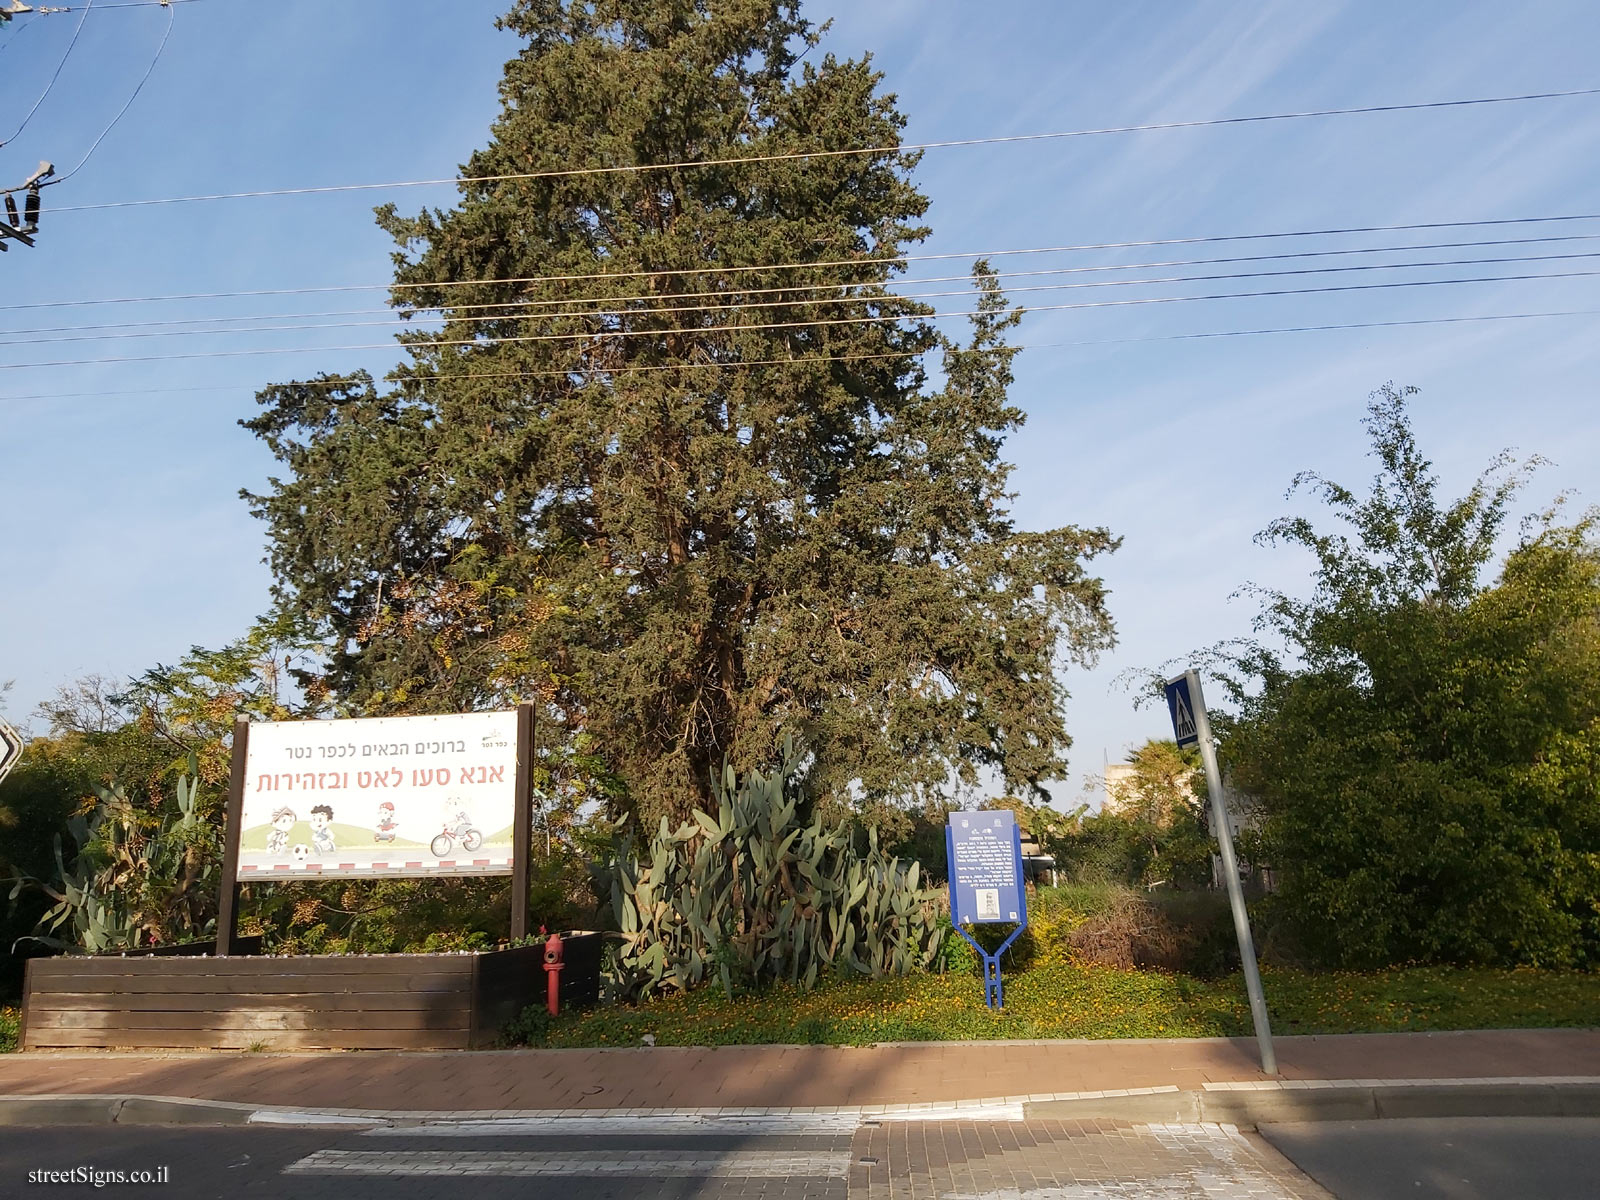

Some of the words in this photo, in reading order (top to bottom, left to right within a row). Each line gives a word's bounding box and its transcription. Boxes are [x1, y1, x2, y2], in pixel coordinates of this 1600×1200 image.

[285, 746, 312, 760] נטר
[318, 743, 356, 758] לכפר
[362, 743, 409, 757] הבאים
[415, 740, 466, 755] ברוכים
[256, 772, 348, 792] ובזהירות
[357, 767, 404, 789] לאט
[412, 767, 451, 787] סעו
[460, 765, 504, 784] אנא
